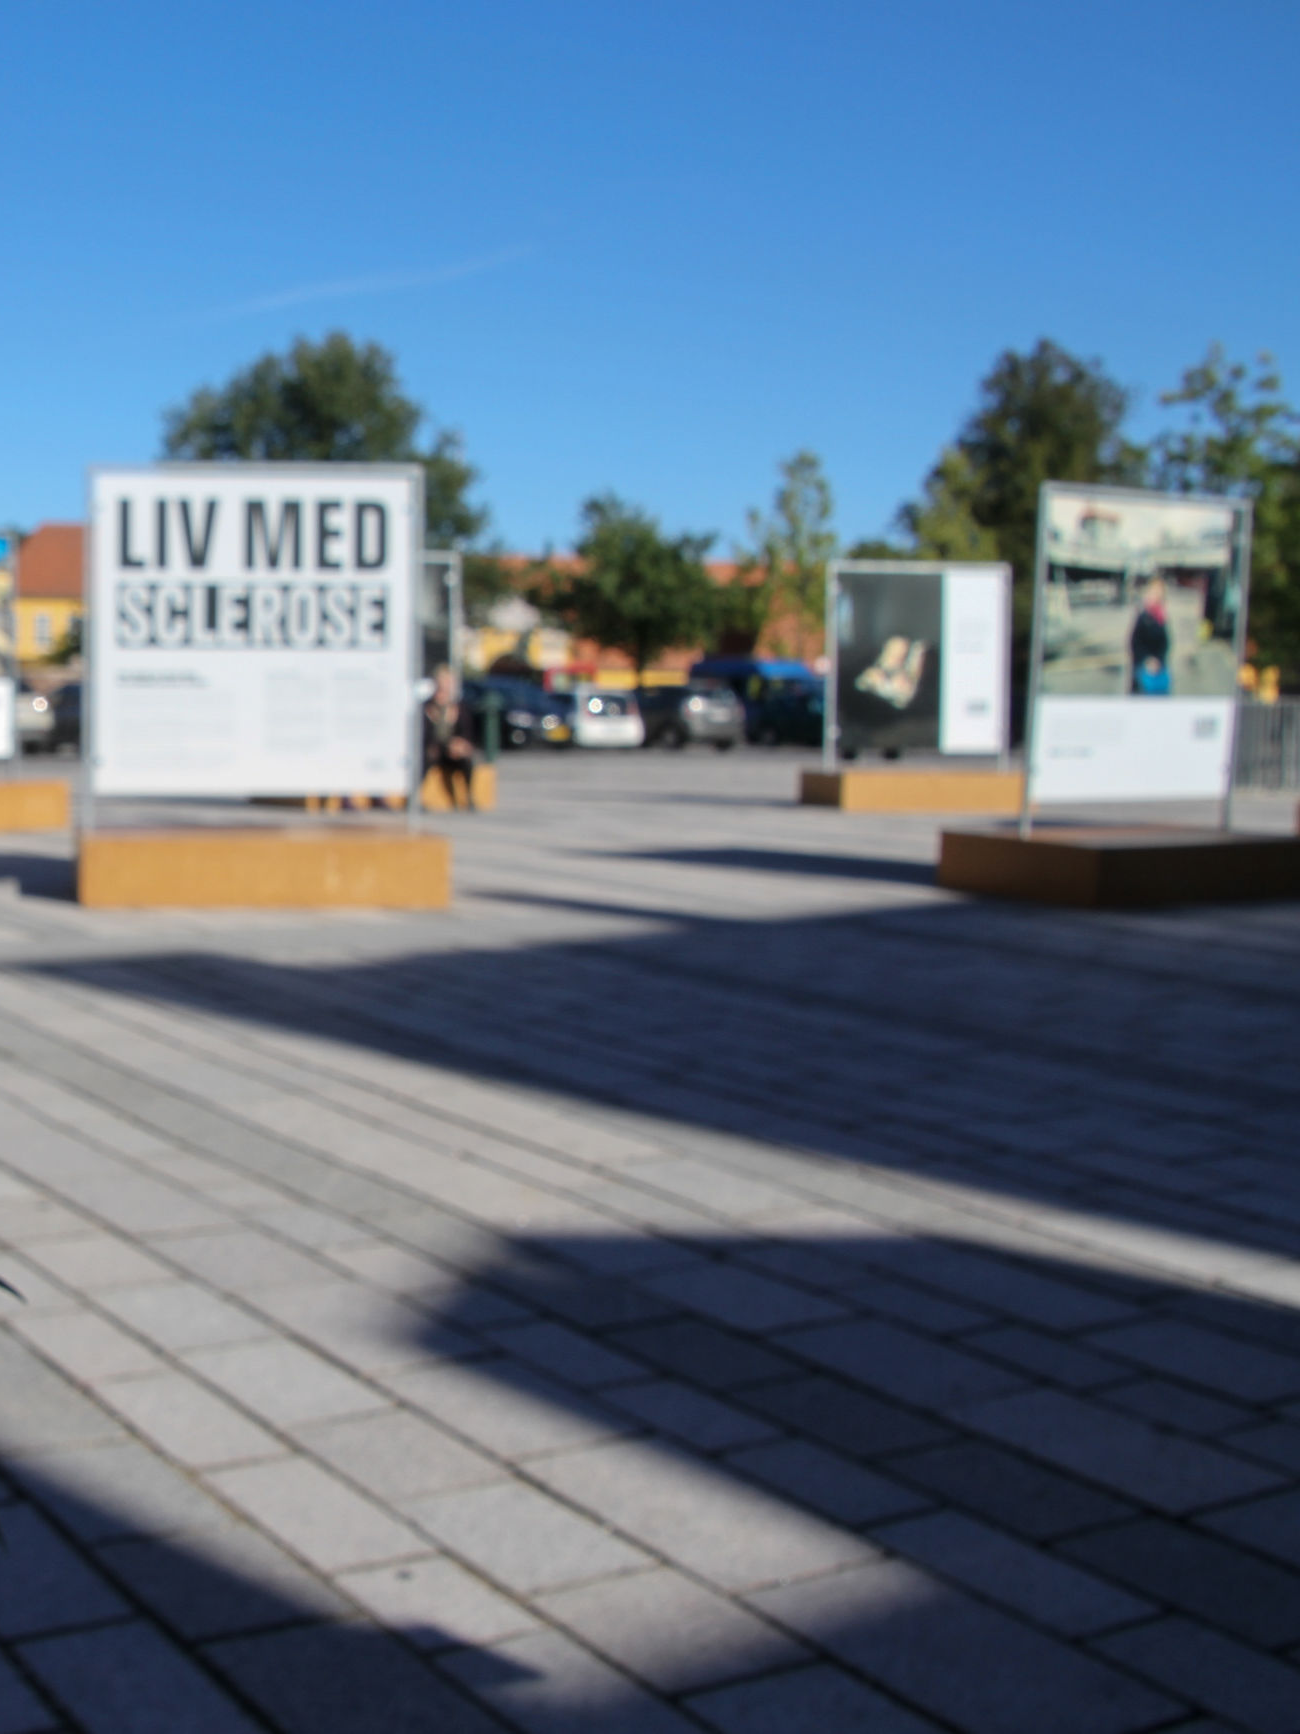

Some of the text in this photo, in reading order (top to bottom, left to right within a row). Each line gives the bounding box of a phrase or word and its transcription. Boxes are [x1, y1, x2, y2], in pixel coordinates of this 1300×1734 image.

[118, 498, 388, 570] LIV MED
[117, 582, 388, 649] SCLEROSE
